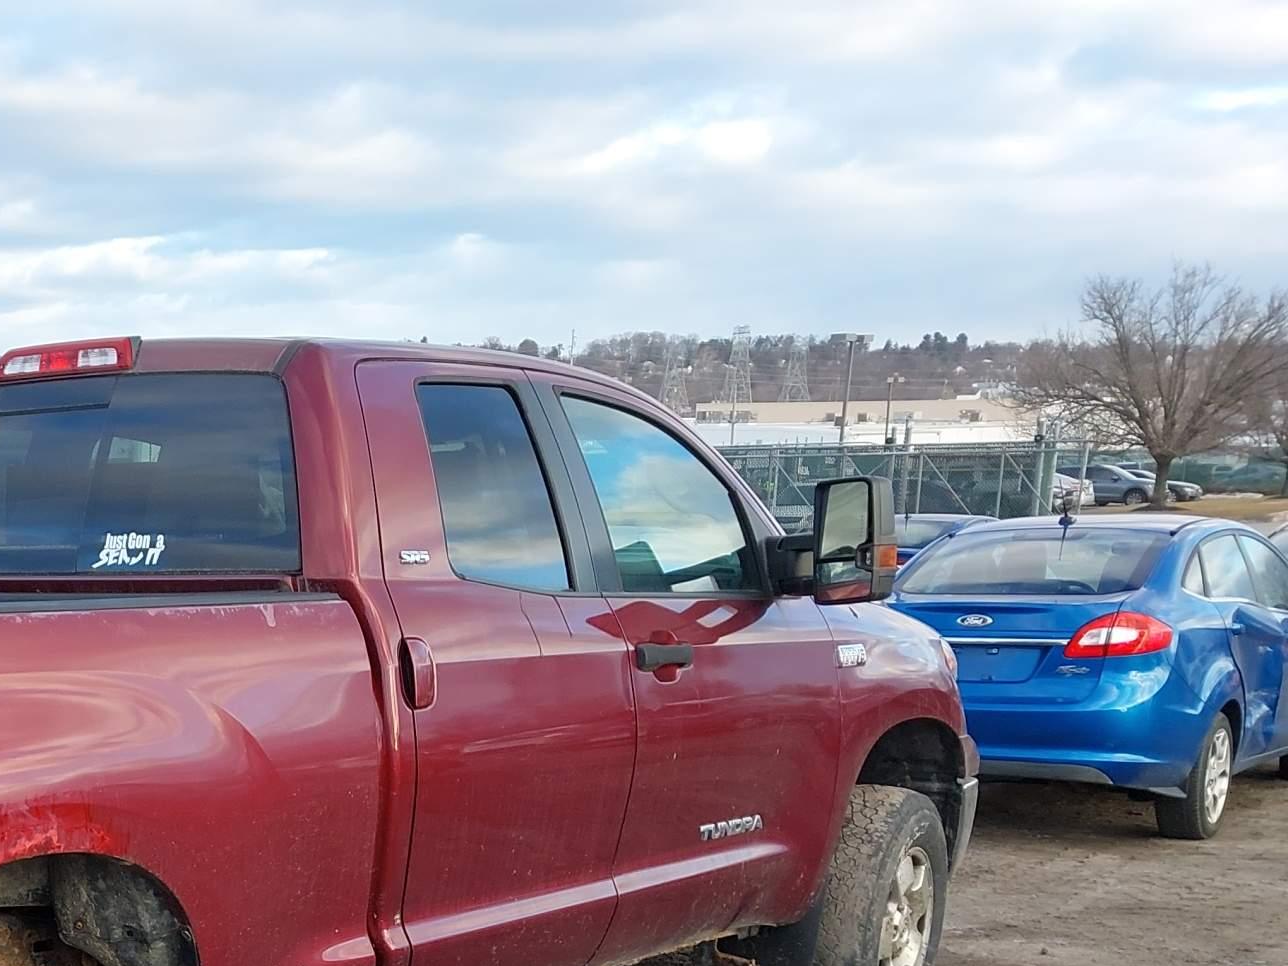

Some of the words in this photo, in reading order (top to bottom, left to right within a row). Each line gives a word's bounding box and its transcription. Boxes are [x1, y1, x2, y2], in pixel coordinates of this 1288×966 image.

[128, 532, 165, 551] Gona
[960, 614, 990, 626] Ford
[699, 814, 763, 841] TUNDRA
